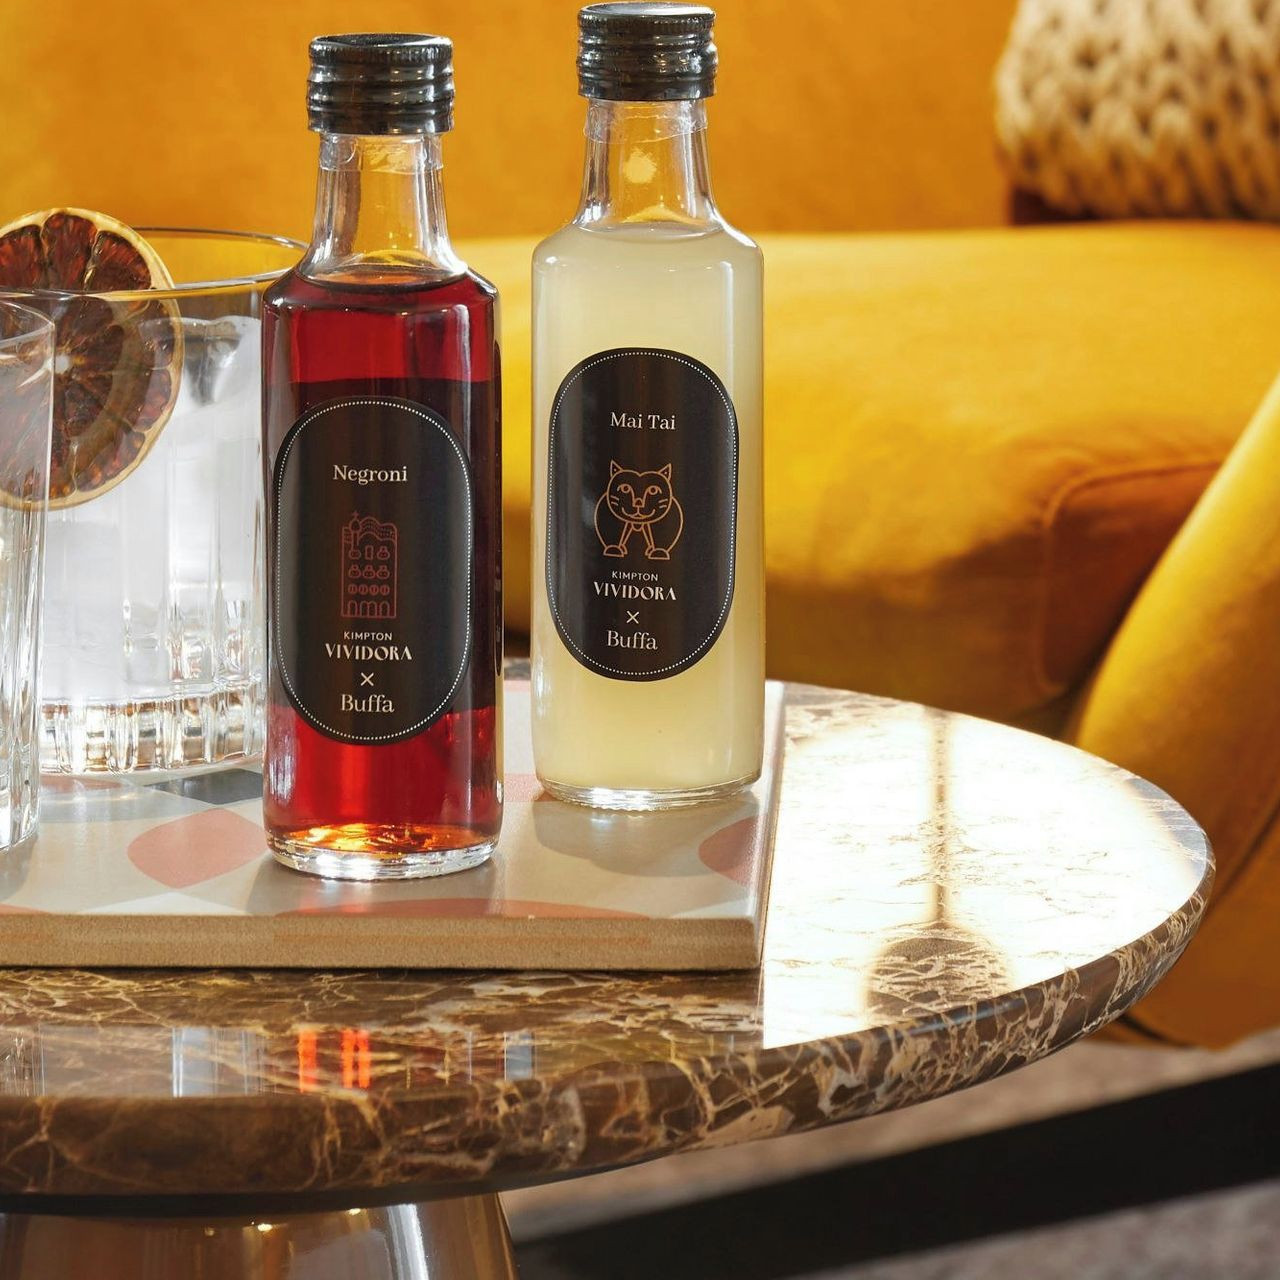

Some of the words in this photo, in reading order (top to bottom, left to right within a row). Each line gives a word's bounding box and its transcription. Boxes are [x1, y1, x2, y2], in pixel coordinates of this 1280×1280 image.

[610, 412, 642, 429] Mai
[648, 414, 676, 431] Tai
[332, 464, 408, 485] Negroni
[612, 570, 659, 581] KIMPTON
[593, 581, 677, 601] VIVIDORA
[343, 631, 393, 641] KIMPTON
[606, 629, 658, 650] Buffa
[325, 643, 413, 661] VIVIDORA
[340, 693, 395, 713] Buffa
